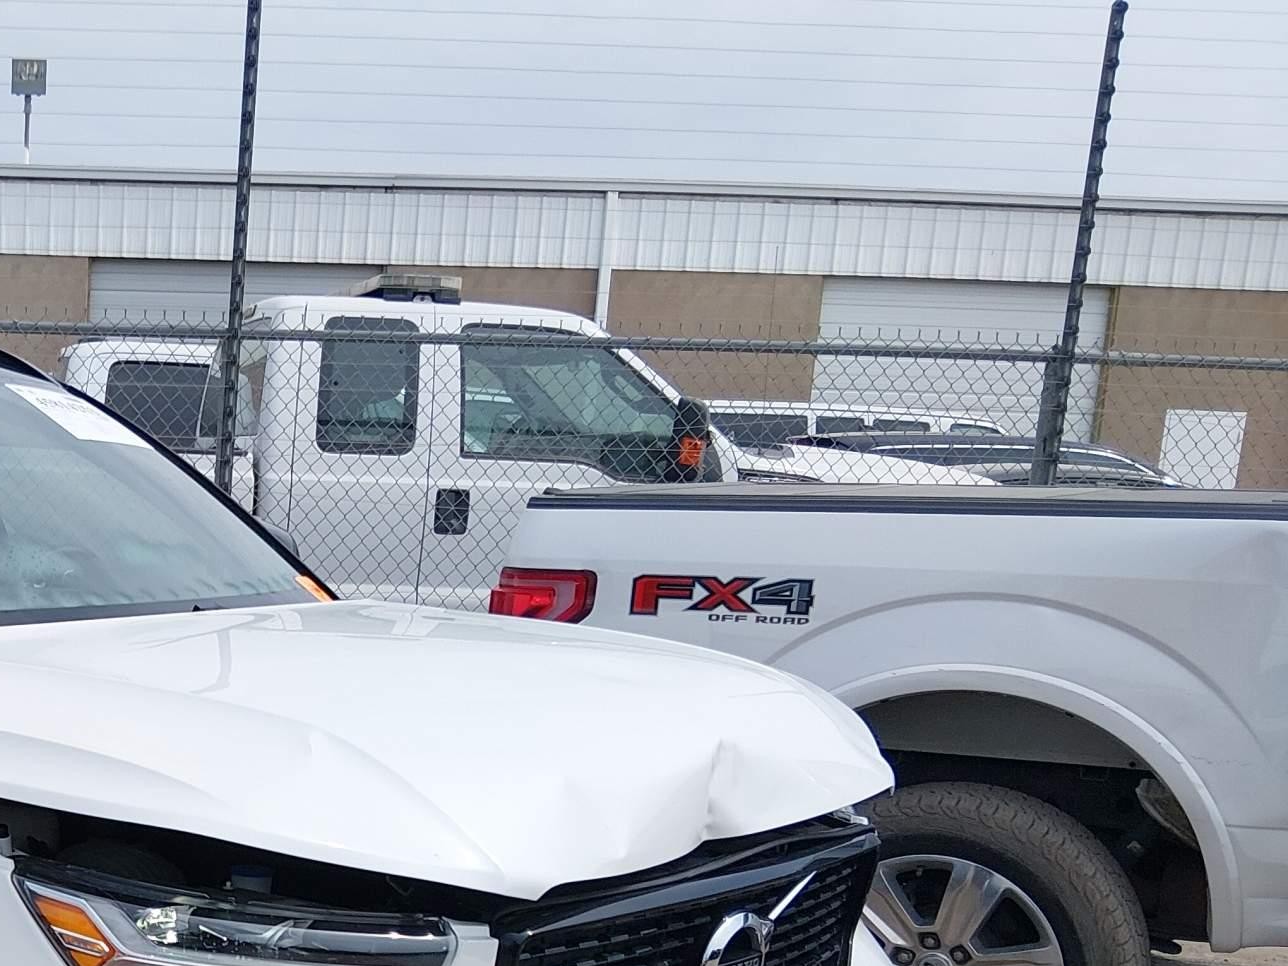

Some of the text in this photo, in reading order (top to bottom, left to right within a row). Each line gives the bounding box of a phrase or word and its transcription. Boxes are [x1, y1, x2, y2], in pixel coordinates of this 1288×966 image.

[629, 574, 816, 616] FX4
[707, 613, 810, 625] OFF ROAD
